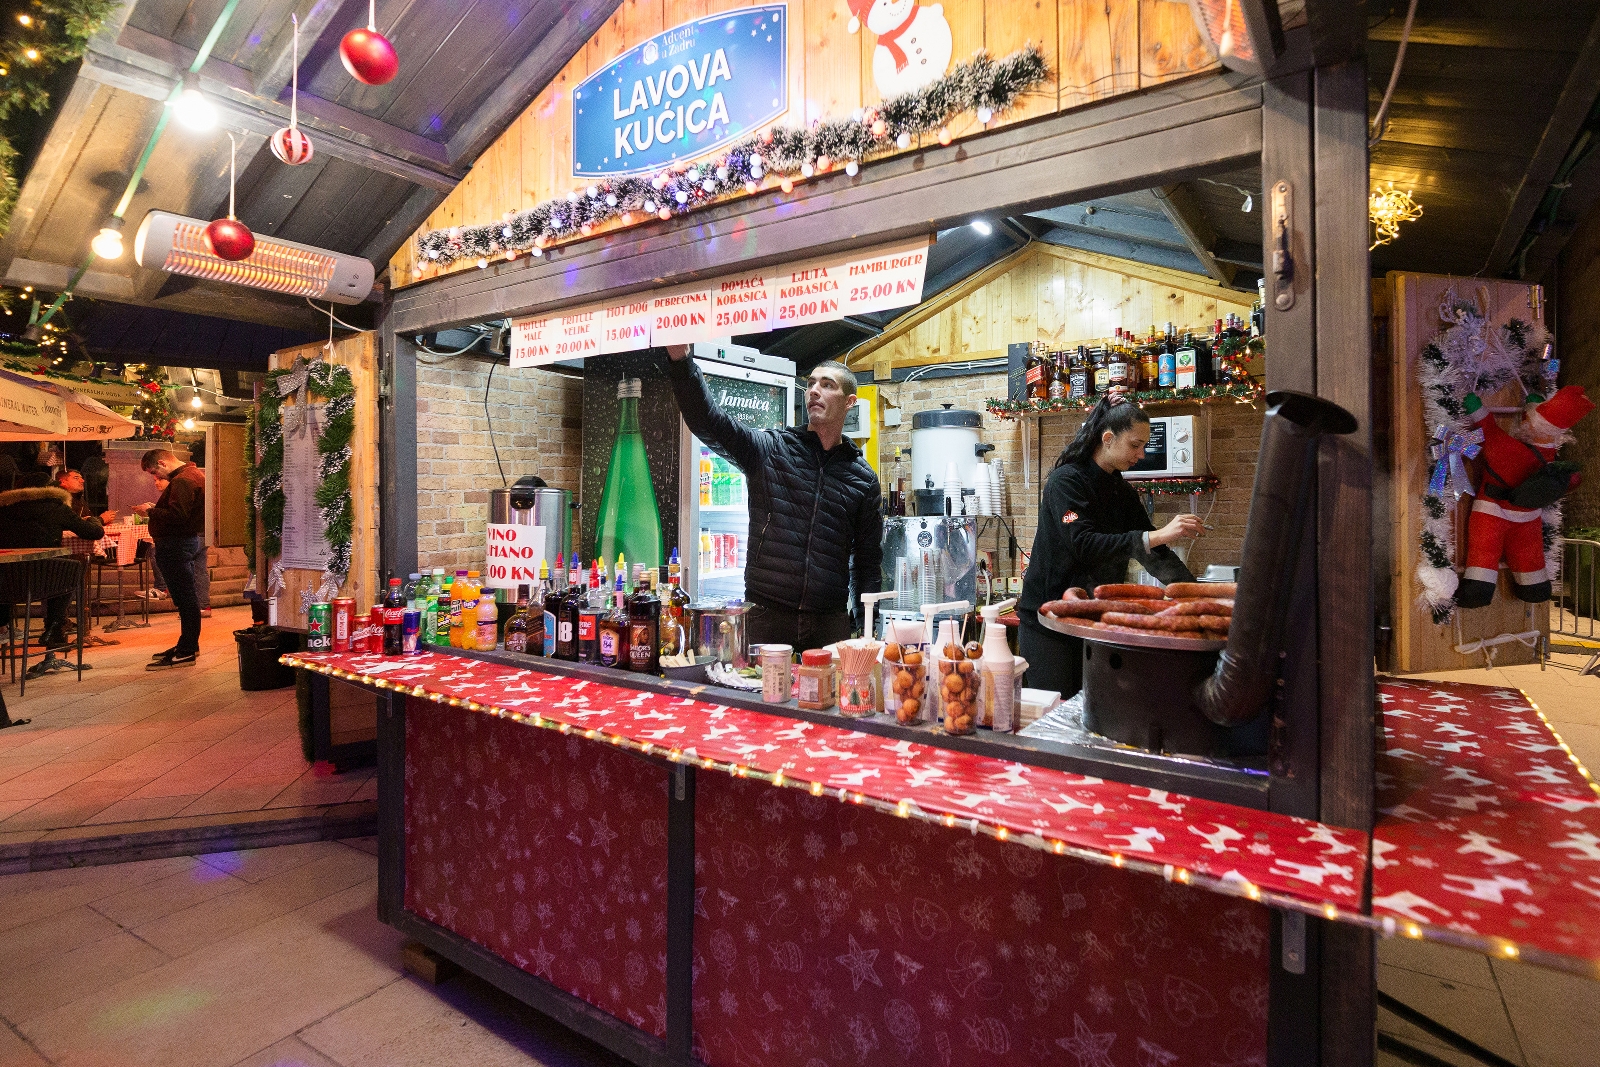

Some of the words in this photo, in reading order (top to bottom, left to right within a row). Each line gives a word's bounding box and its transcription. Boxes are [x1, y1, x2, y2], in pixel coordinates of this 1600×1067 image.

[662, 25, 694, 47] Advent
[669, 38, 696, 56] Zadru
[613, 48, 732, 120] LAVOVA
[614, 91, 731, 159] KUĆICA
[849, 254, 923, 276] HAMBURGER
[721, 274, 764, 292] DOMAĆA
[791, 267, 828, 283] LJUTA
[780, 280, 839, 298] KOBASICA
[850, 282, 892, 301] 25,00
[896, 278, 917, 294] KN
[654, 292, 708, 308] DEBRECINKA
[716, 290, 768, 306] KOBASICA
[606, 306, 626, 318] HOT
[629, 301, 648, 315] DOG
[716, 309, 749, 326] 25,00
[751, 307, 768, 321] KN
[780, 301, 817, 319] 25,00
[821, 298, 839, 313] KN
[656, 313, 688, 330] 20,00
[690, 312, 706, 326] KN
[524, 331, 542, 342] MALE
[564, 324, 591, 336] VELIKE
[633, 325, 646, 338] KN
[539, 345, 549, 356] KN
[584, 339, 596, 351] KN
[719, 389, 770, 412] Jamnica
[487, 527, 517, 542] VINO
[511, 566, 535, 580] KN
[603, 640, 612, 649] 84
